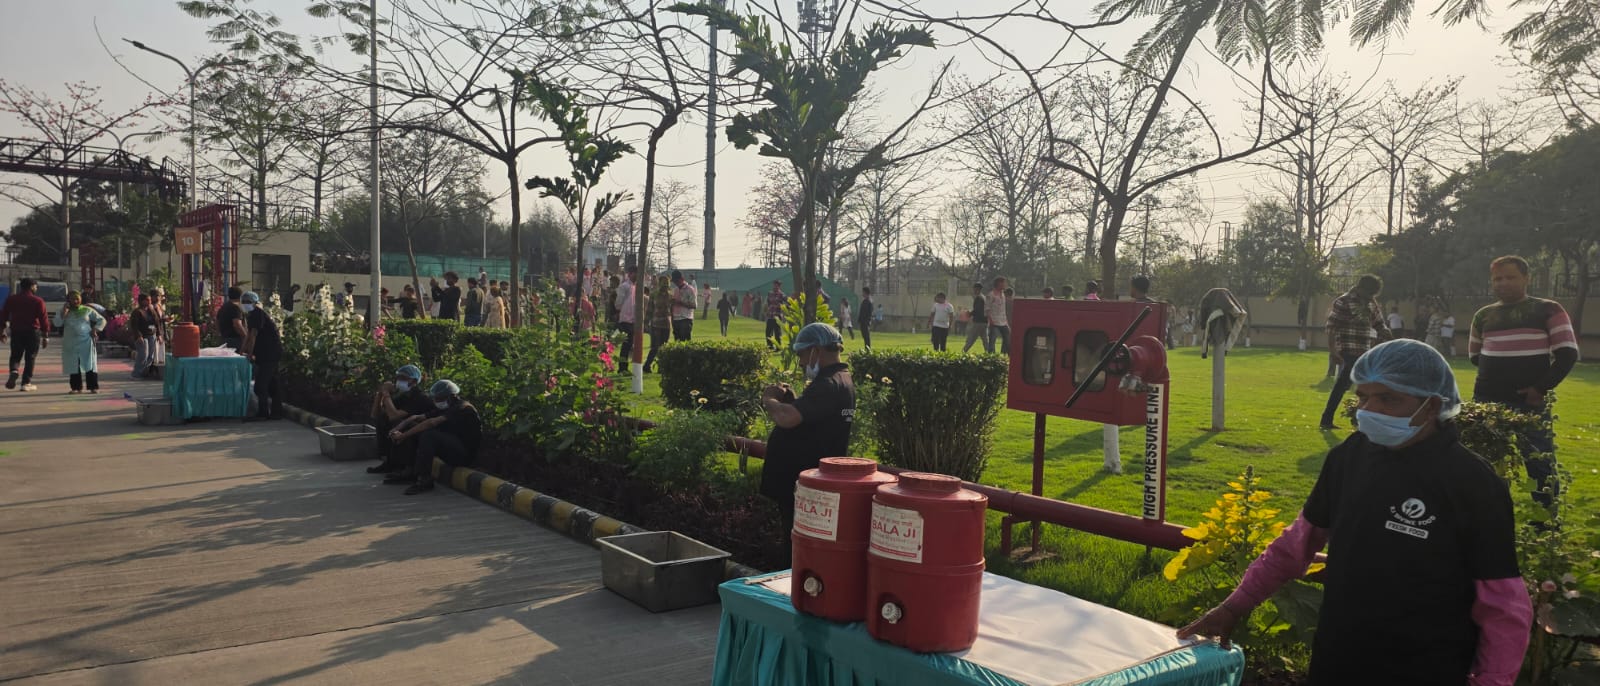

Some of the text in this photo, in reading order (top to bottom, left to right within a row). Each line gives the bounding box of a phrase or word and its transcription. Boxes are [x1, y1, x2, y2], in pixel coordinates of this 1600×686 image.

[181, 236, 194, 246] 10
[1144, 384, 1159, 517] HIGH PRESSURE LINE
[821, 508, 832, 518] JI
[872, 519, 899, 537] BALA
[903, 528, 916, 539] JI
[1408, 528, 1425, 537] FOOD
